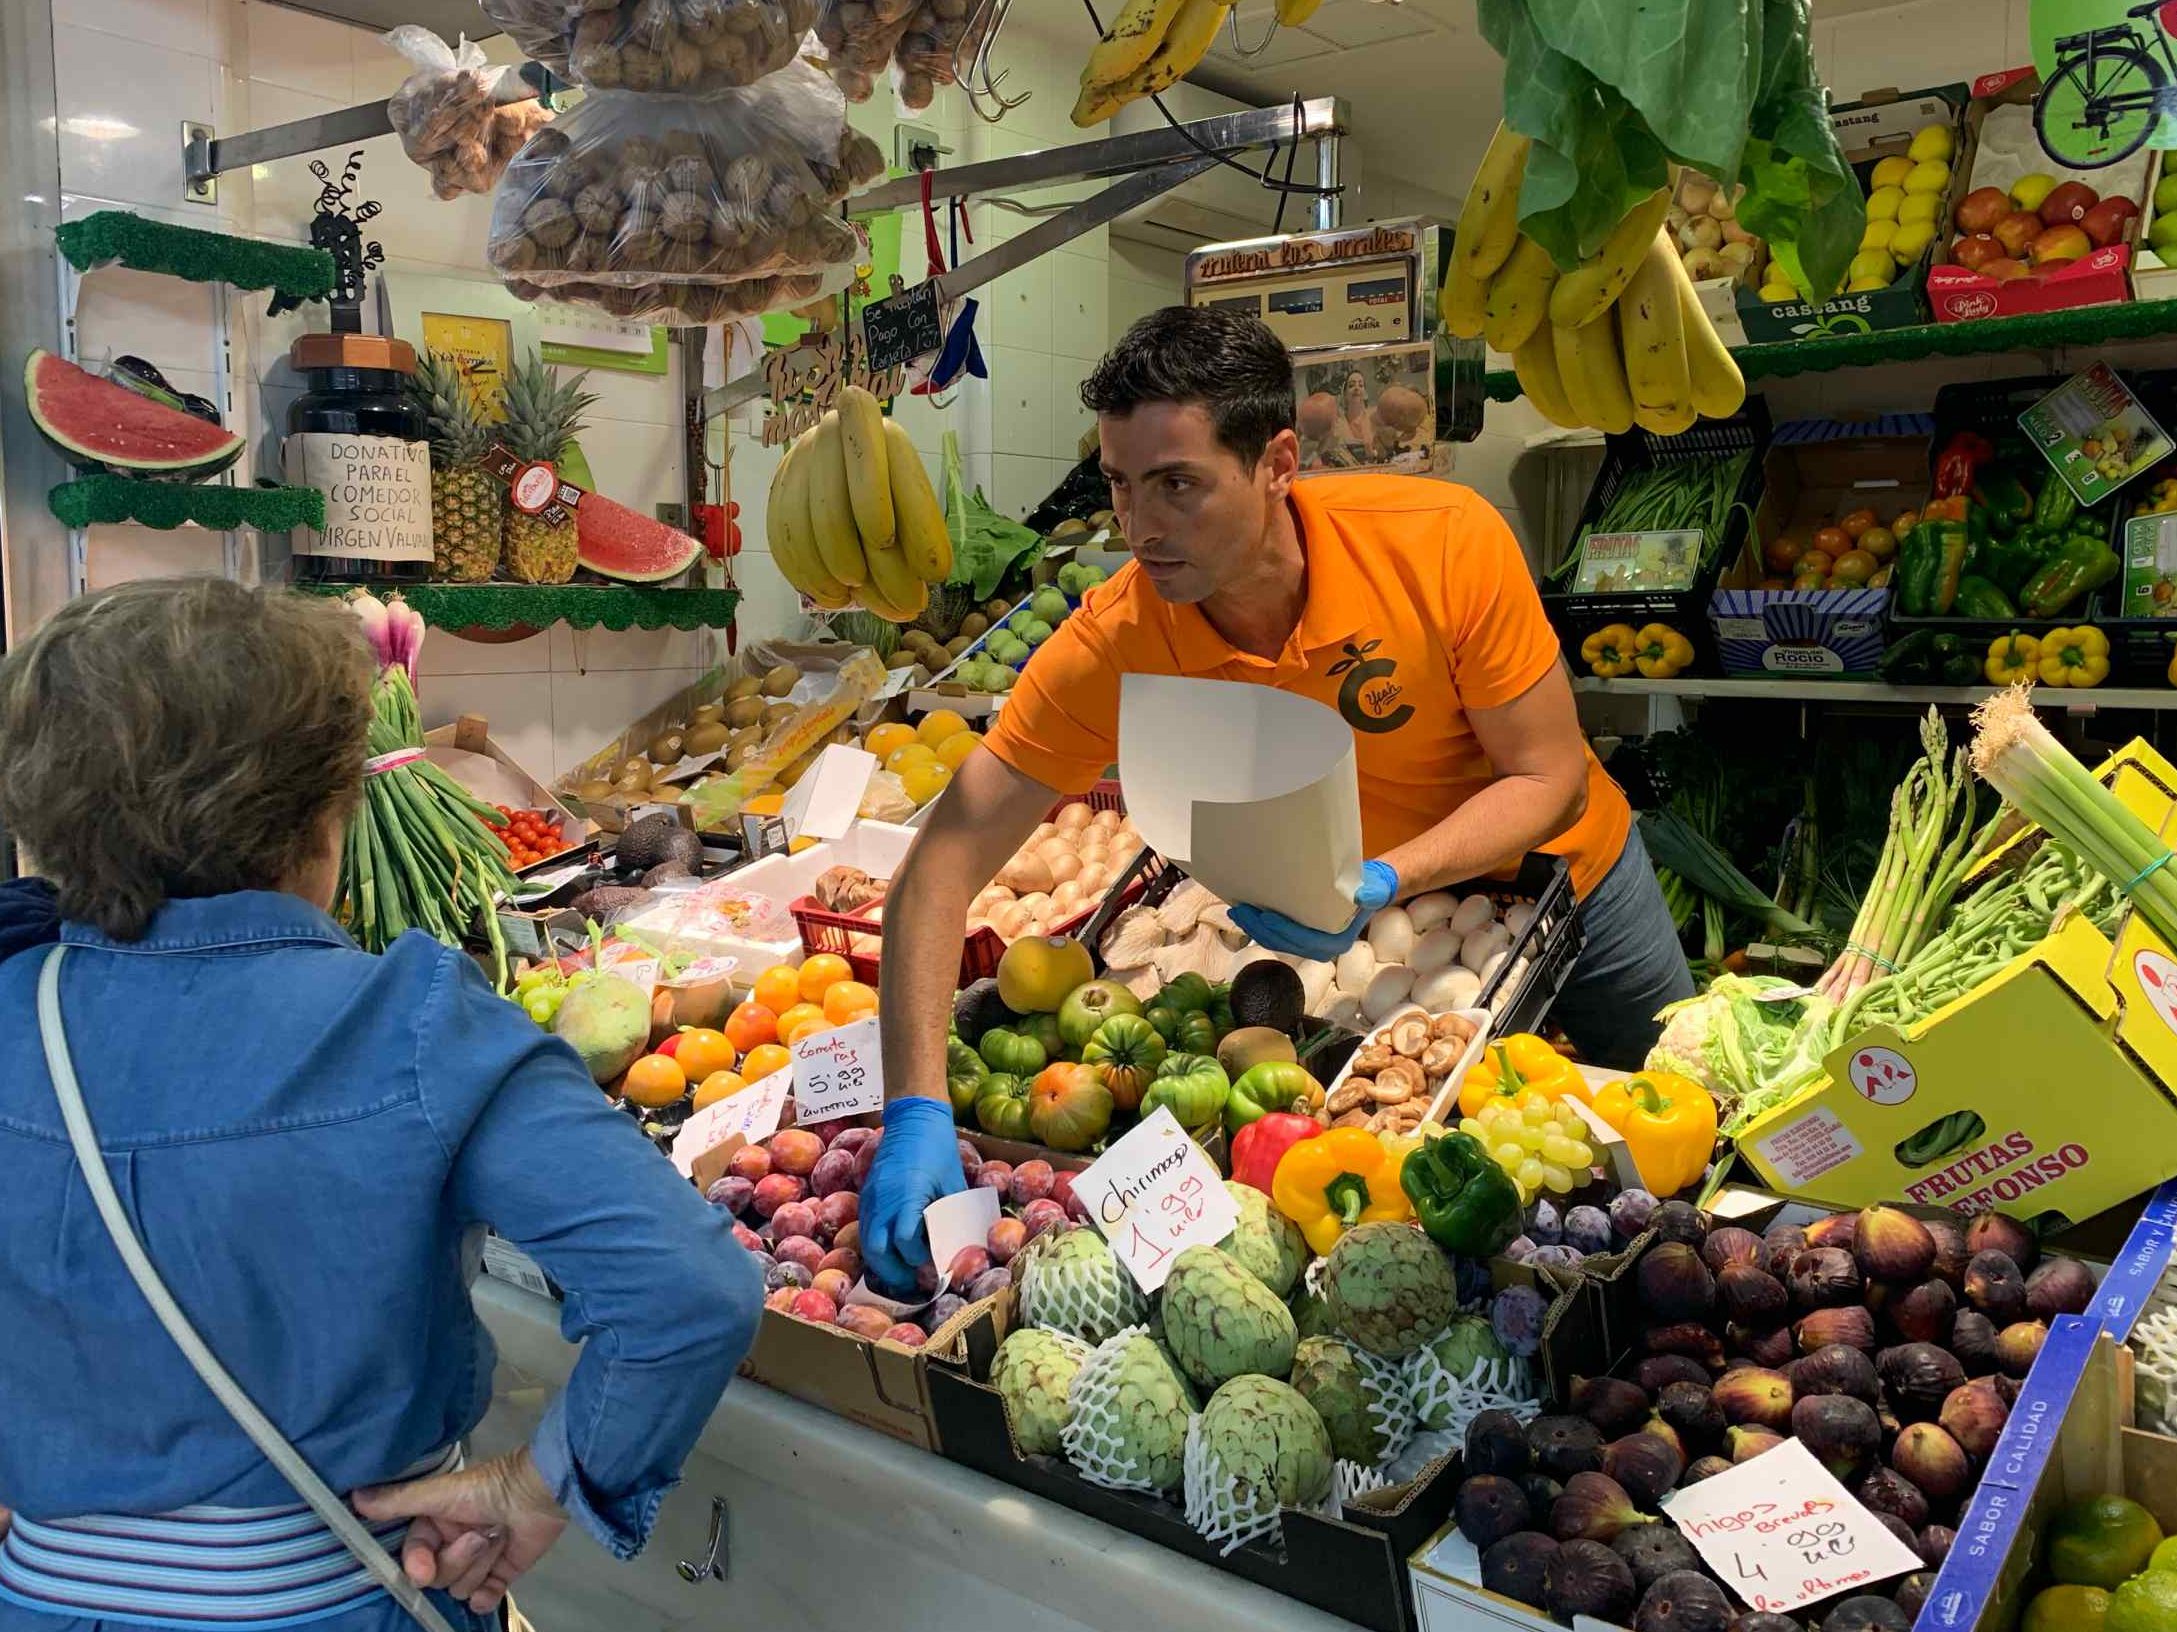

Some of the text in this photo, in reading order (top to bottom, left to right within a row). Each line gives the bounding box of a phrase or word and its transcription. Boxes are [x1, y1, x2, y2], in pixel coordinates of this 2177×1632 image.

[1835, 113, 1880, 128] astang
[865, 306, 882, 323] Se
[1772, 295, 1872, 320] casang
[331, 443, 425, 464] DONATIVO
[331, 484, 422, 506] COMEDOR
[350, 505, 416, 524] SOCIAL
[319, 524, 383, 549] VIRGEN
[1904, 1130, 2034, 1205] FRUTAS
[2128, 1238, 2162, 1278] SABOR
[2152, 1228, 2166, 1238] Y
[1969, 1495, 2008, 1558] SABOR
[2006, 1400, 2049, 1475] CALIDAD
[1684, 1503, 1778, 1538] higos
